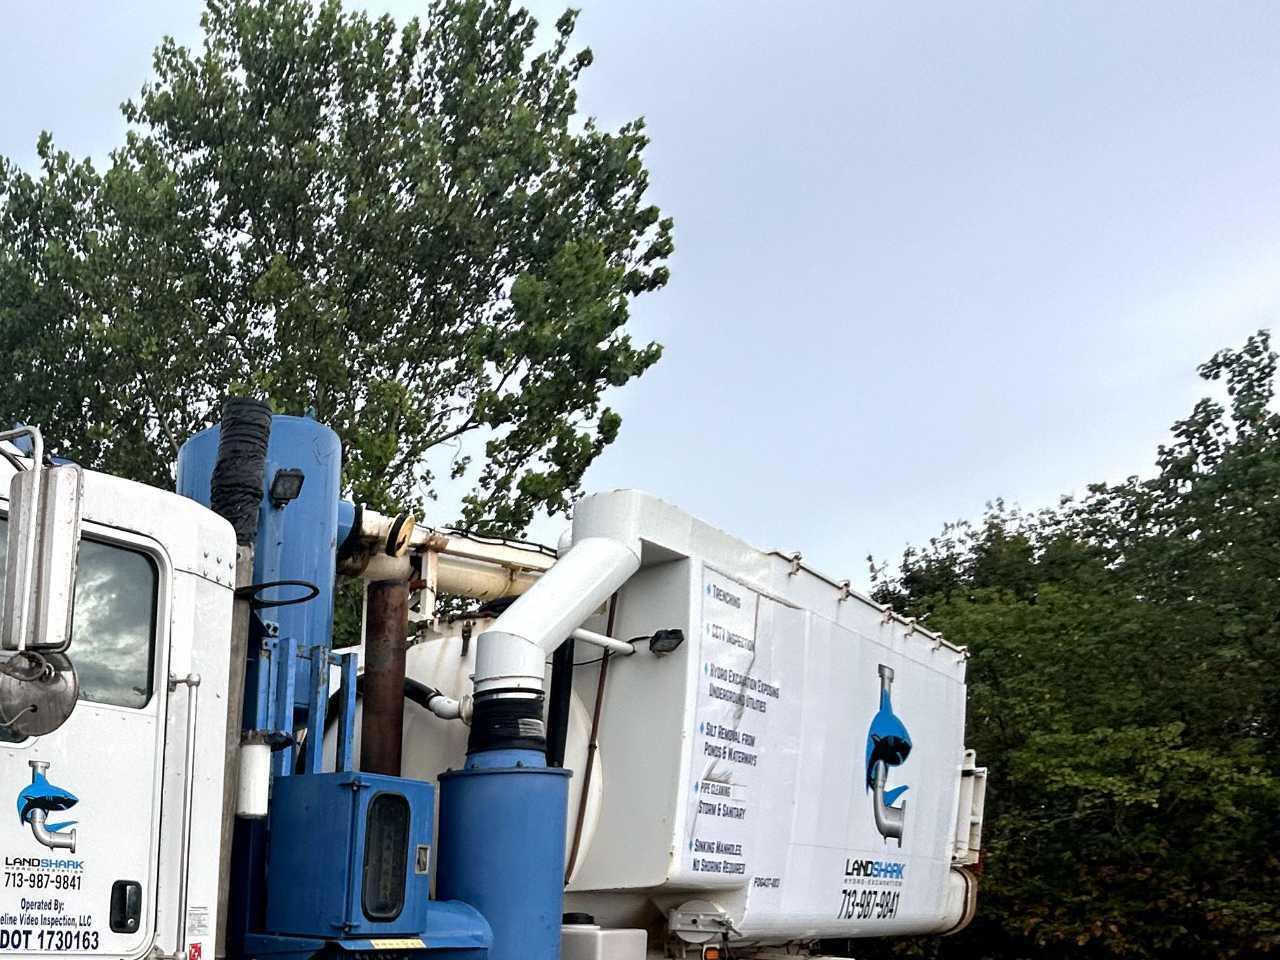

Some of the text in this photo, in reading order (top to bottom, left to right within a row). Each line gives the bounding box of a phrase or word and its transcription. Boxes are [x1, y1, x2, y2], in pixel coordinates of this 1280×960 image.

[710, 663, 728, 681] HYDRO
[729, 670, 757, 691] EXCAVATION
[709, 683, 766, 713] UNDERGROUND UTILITIES
[706, 722, 756, 747] SILT REMOVAL FROM
[704, 741, 721, 759] PONDS
[728, 747, 757, 766] WATERWAYS
[700, 782, 731, 798] PIPE CLEANING
[699, 800, 716, 816] STORM
[722, 804, 746, 820] SANITARY
[695, 838, 715, 853] SINKING
[4, 856, 84, 870] LANDSHARK
[693, 858, 746, 875] NO SHORING REQUIRED
[845, 859, 906, 879] LANDSHARK
[4, 872, 81, 890] 713-987-9841
[20, 897, 65, 914] Operated By:
[837, 889, 901, 919] 713-987-9841
[19, 913, 39, 926] Video
[40, 914, 78, 928] Inspection,
[79, 915, 92, 927] LLC
[38, 930, 100, 950] 1730163
